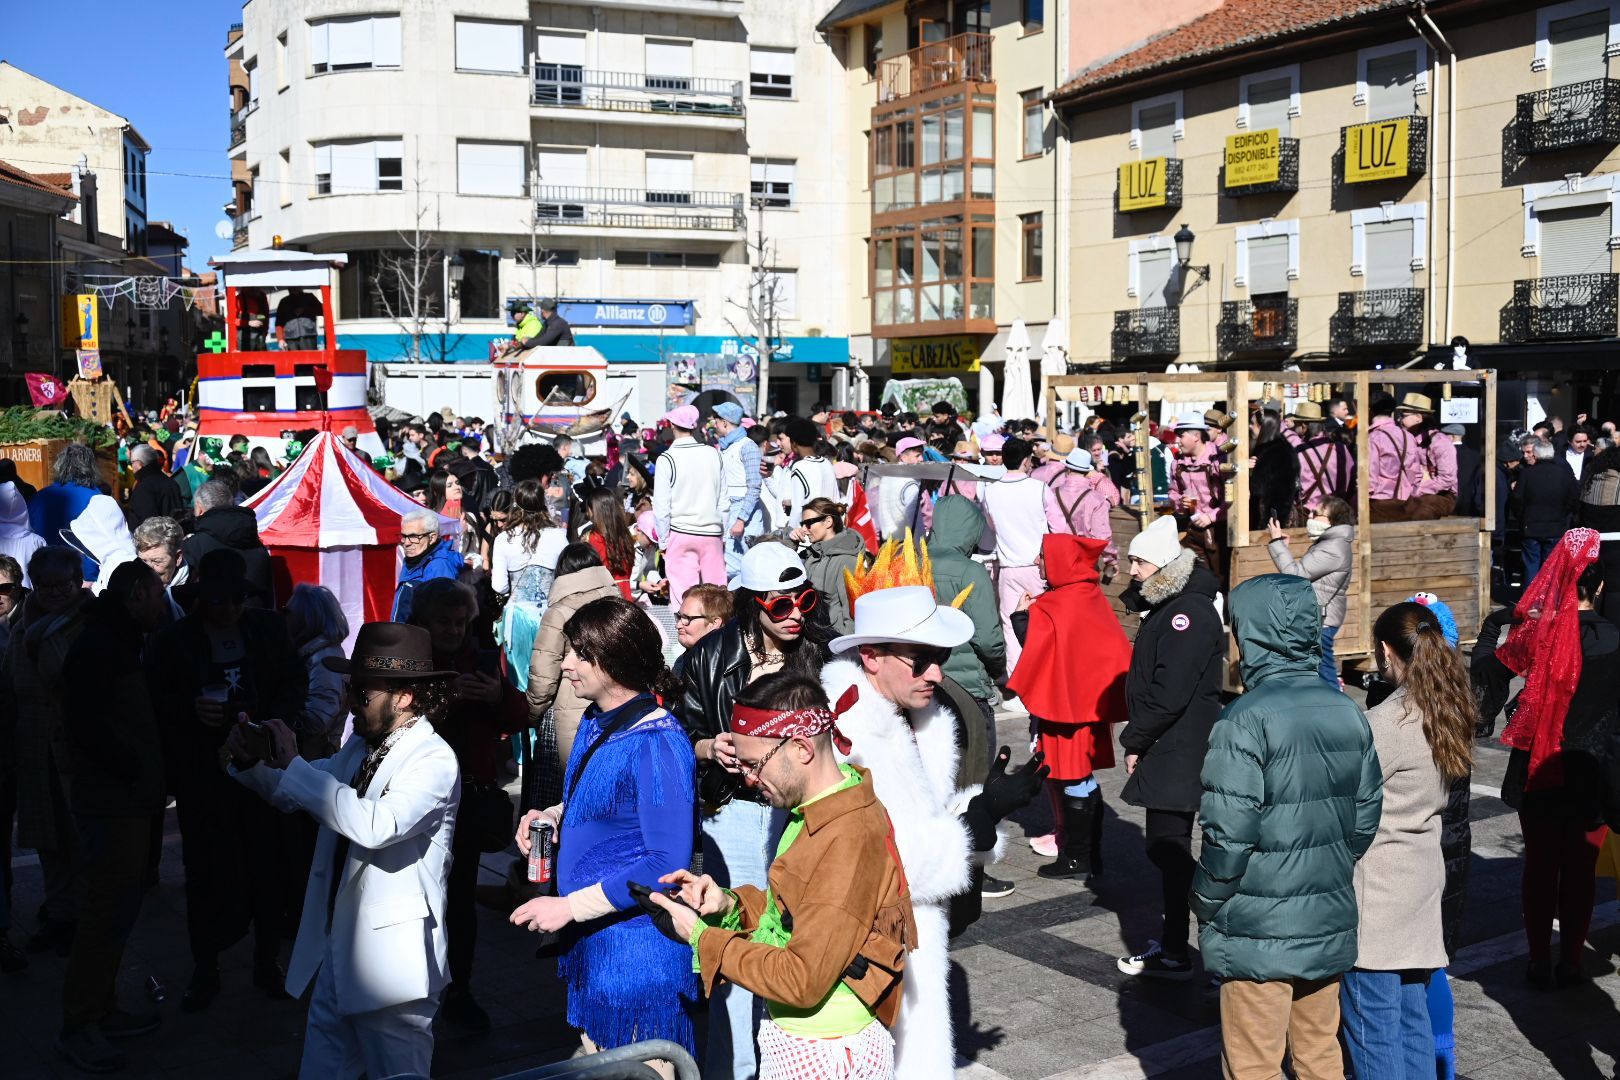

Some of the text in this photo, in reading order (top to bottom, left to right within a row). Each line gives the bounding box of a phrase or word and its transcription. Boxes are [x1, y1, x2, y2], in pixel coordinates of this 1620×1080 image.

[1234, 132, 1269, 149] EDIFICIO
[1359, 123, 1397, 170] LUZ
[1227, 146, 1276, 165] DISPONIBLE
[1129, 160, 1157, 200] LUZ
[594, 304, 645, 320] Allianz
[910, 343, 961, 369] CABEZAS
